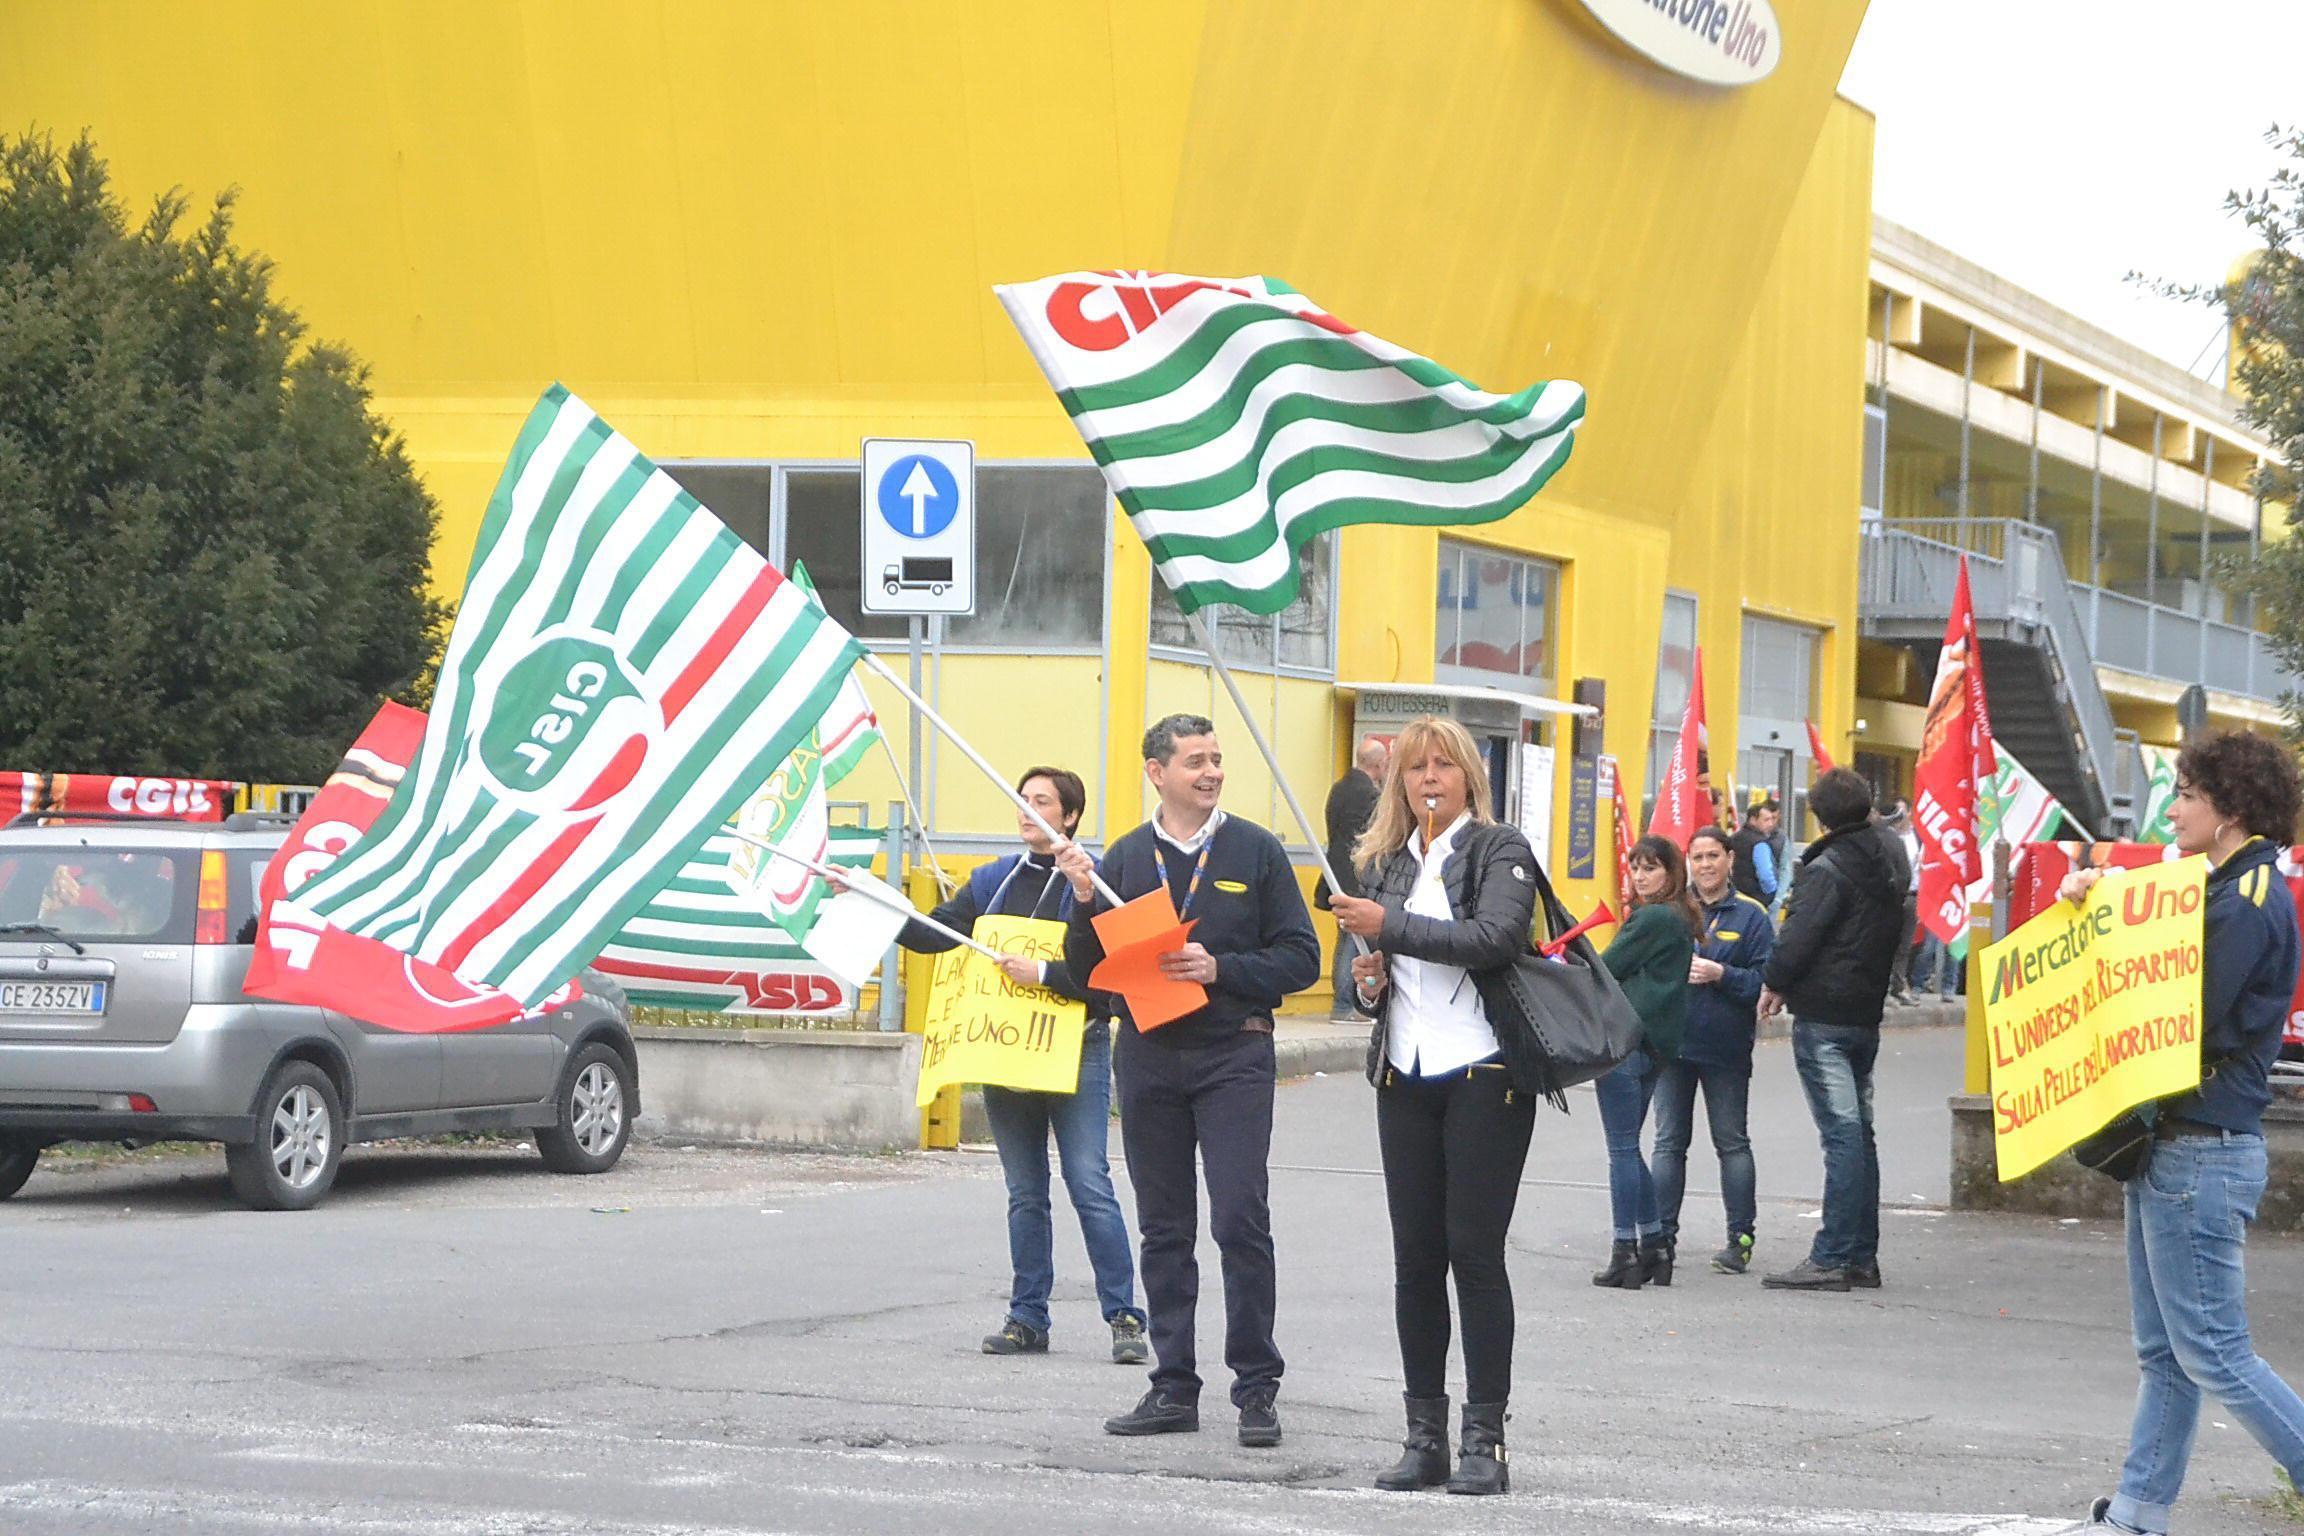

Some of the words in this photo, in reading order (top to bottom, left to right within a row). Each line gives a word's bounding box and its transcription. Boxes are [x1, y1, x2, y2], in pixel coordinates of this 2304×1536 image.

[1723, 0, 1768, 68] Uno
[1363, 693, 1449, 713] FOTOTESSERA
[107, 776, 212, 814] CGIL
[1988, 904, 2113, 1006] Mercatone
[2123, 882, 2201, 926] Uno
[998, 975, 1071, 1007] NOSTRO
[967, 1013, 1020, 1046] UNO
